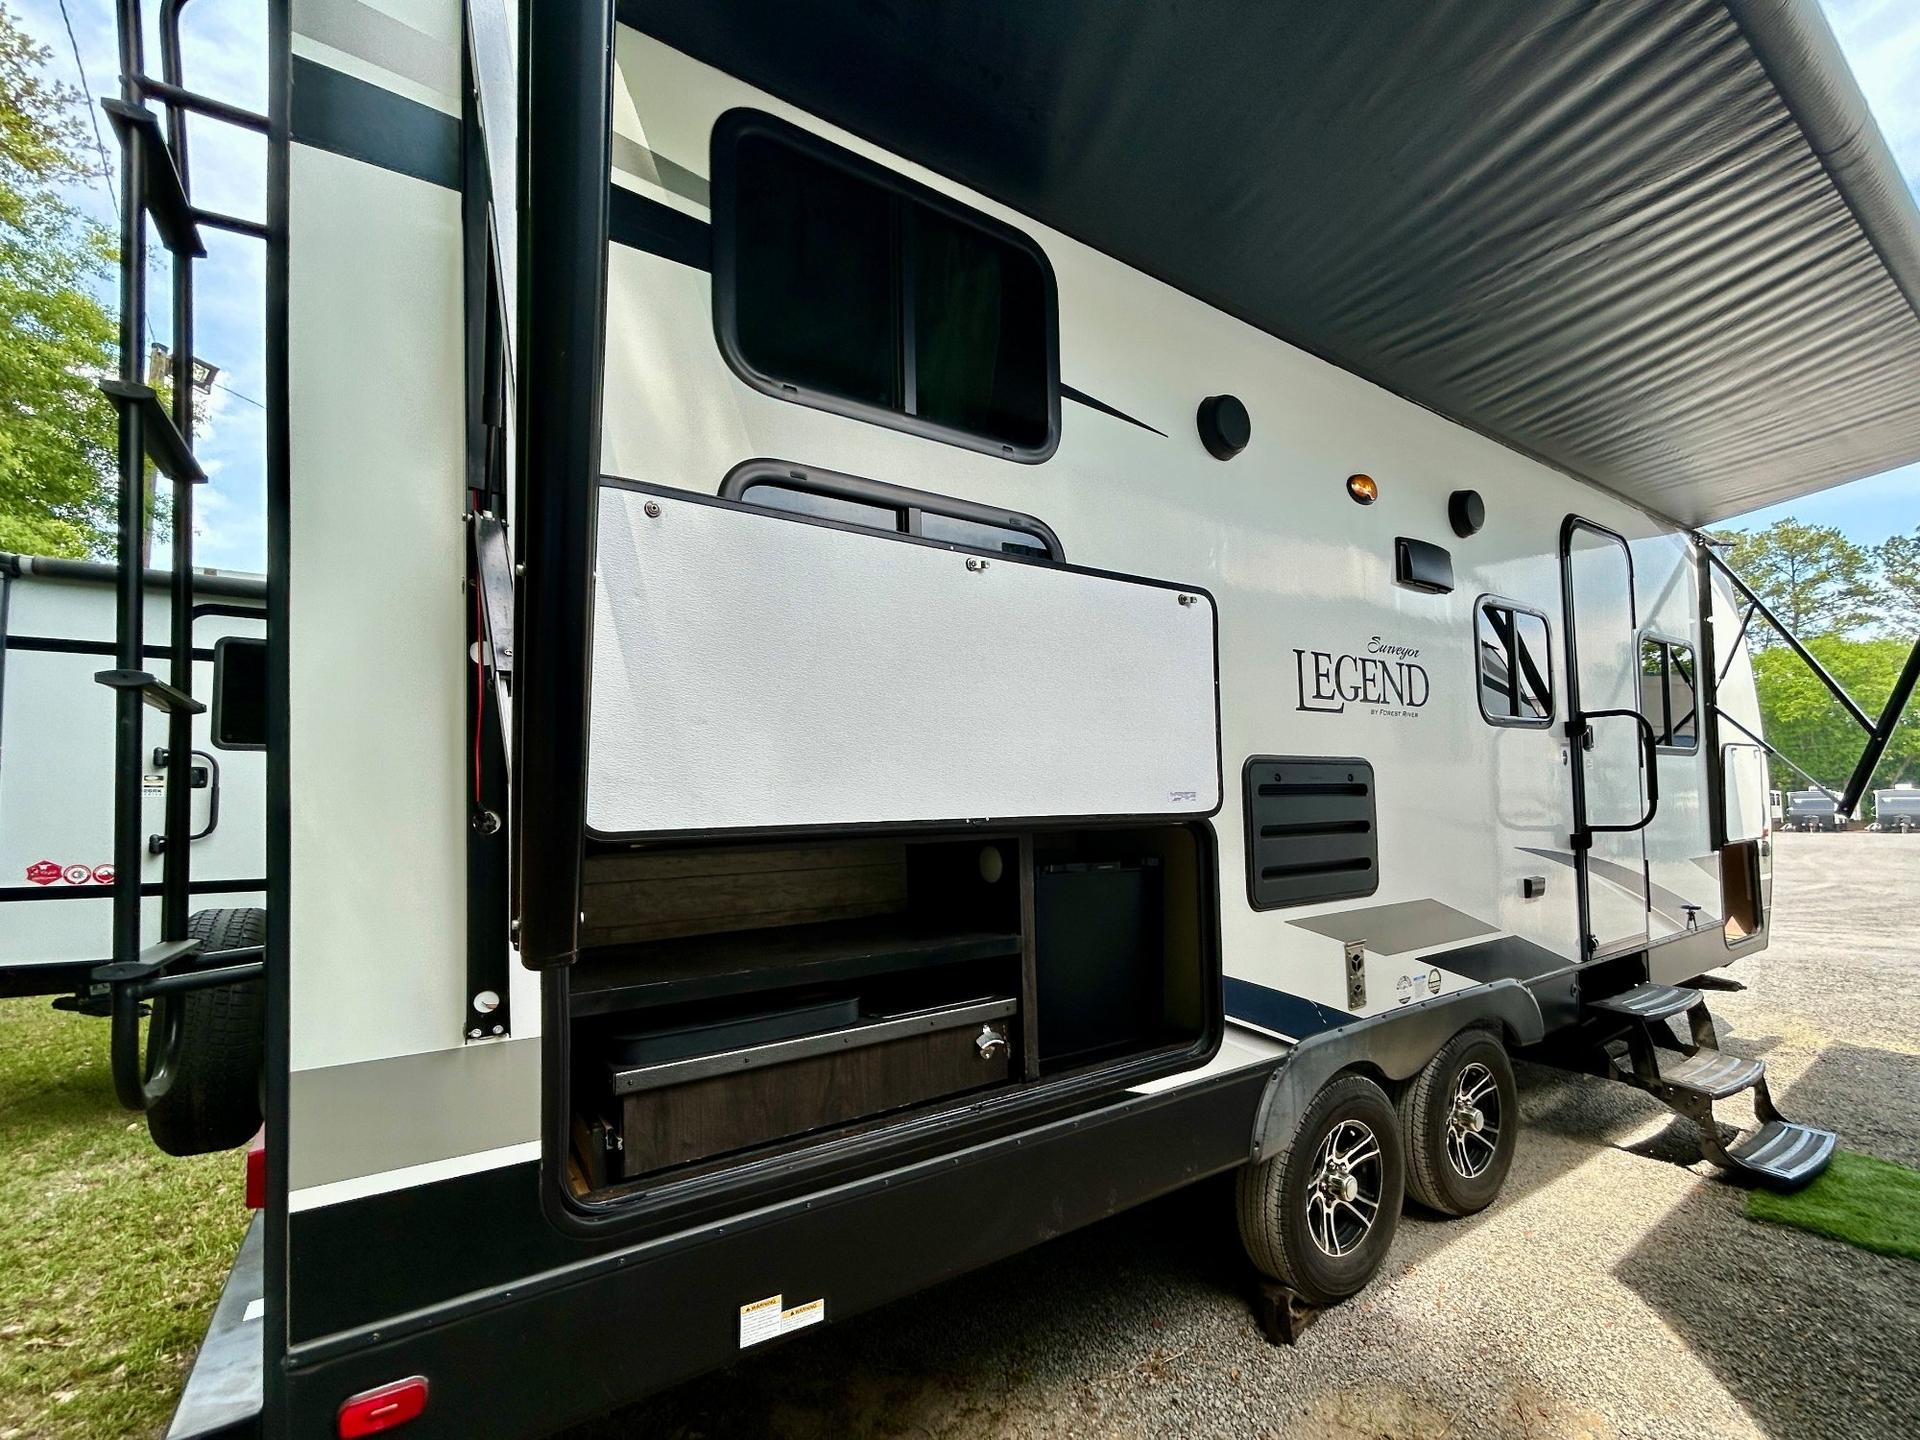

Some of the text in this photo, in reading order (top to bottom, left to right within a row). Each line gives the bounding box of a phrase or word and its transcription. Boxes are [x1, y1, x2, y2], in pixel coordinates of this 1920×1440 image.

[1367, 636, 1420, 660] Surveyor
[1292, 649, 1429, 713] LEGEND
[1379, 709, 1401, 717] FOREST
